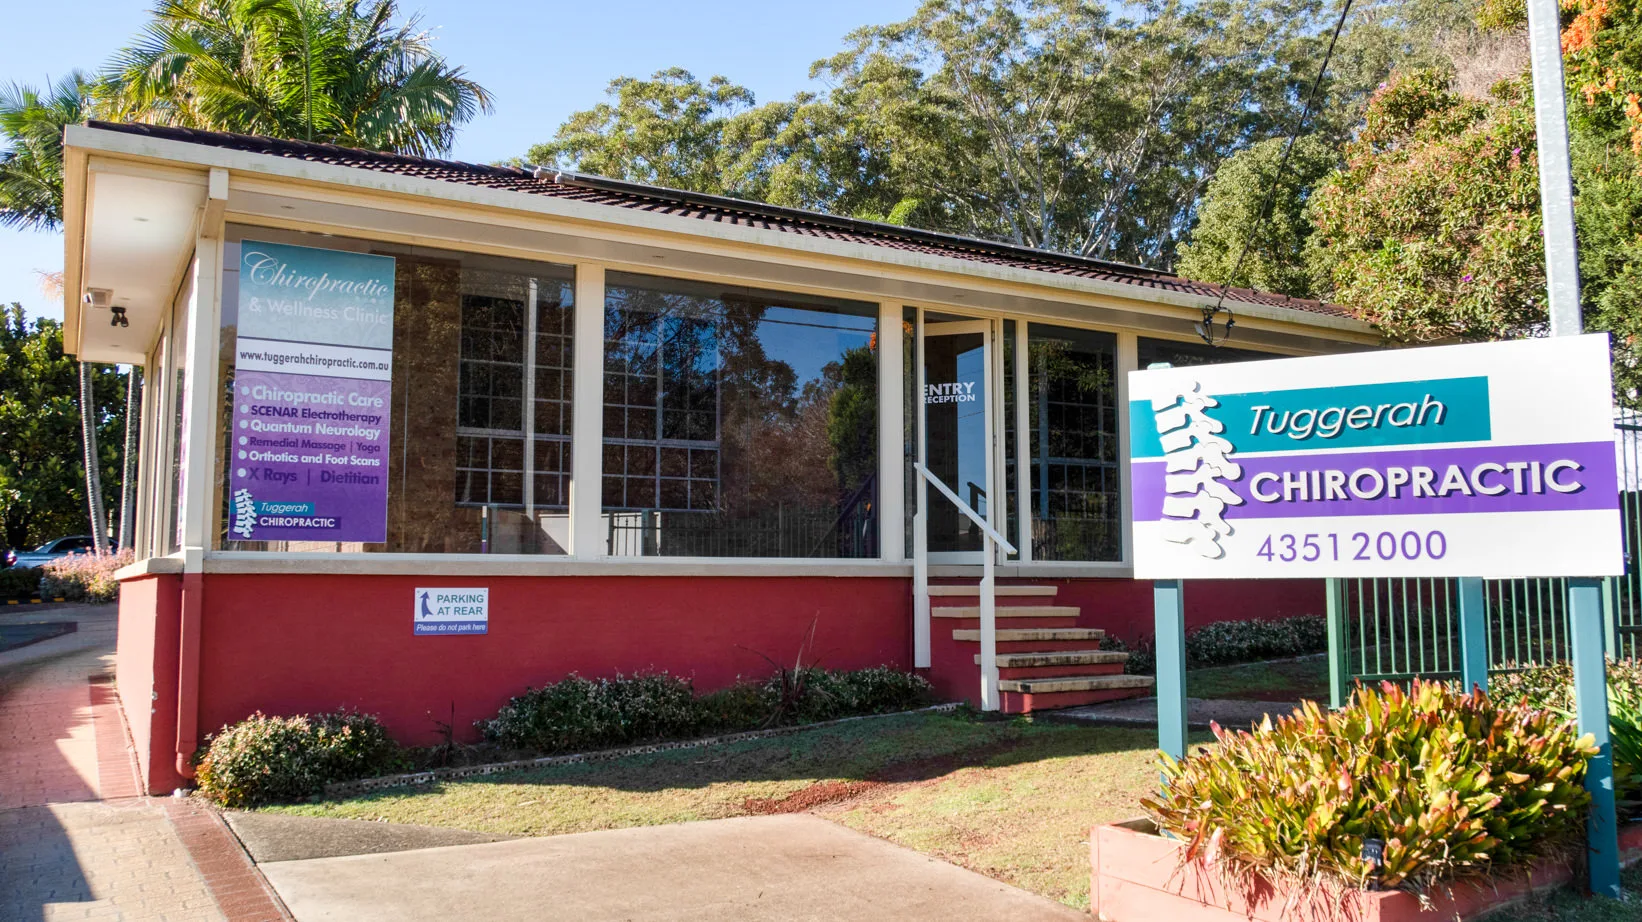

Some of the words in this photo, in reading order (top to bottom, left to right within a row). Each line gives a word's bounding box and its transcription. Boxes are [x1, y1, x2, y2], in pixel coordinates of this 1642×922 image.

[244, 251, 389, 301] Chiropractic
[249, 296, 262, 313] &
[267, 298, 338, 320] Wellness
[343, 306, 388, 325] Clinic
[240, 350, 389, 371] www.tuggerahchiropractic.com.au
[252, 385, 344, 405] Chiropractic
[348, 392, 384, 408] Care
[251, 405, 298, 418] SCENAR
[301, 408, 382, 425] Electrotherapy
[1249, 393, 1445, 440] Tuggerah
[250, 419, 312, 434] Quantum
[315, 423, 381, 441] Neurology
[250, 437, 299, 449] Remedial
[301, 440, 346, 451] Massage
[356, 442, 381, 454] Yoga
[249, 451, 299, 463] Orthotics
[301, 453, 322, 463] and
[325, 454, 348, 465] Foot
[350, 456, 380, 467] Scans
[248, 467, 260, 480] X
[264, 468, 298, 485] Rays
[320, 470, 380, 485] Dietitian
[1249, 459, 1584, 503] CHIROPRACTIC
[260, 502, 309, 514] Tuggerah
[260, 516, 336, 528] CHIROPRACTIC
[437, 594, 484, 603] PARKING
[437, 606, 451, 615] AT
[454, 606, 483, 615] REAR
[416, 623, 437, 632] Please
[438, 623, 447, 631] do
[458, 623, 471, 632] park
[472, 623, 486, 631] here
